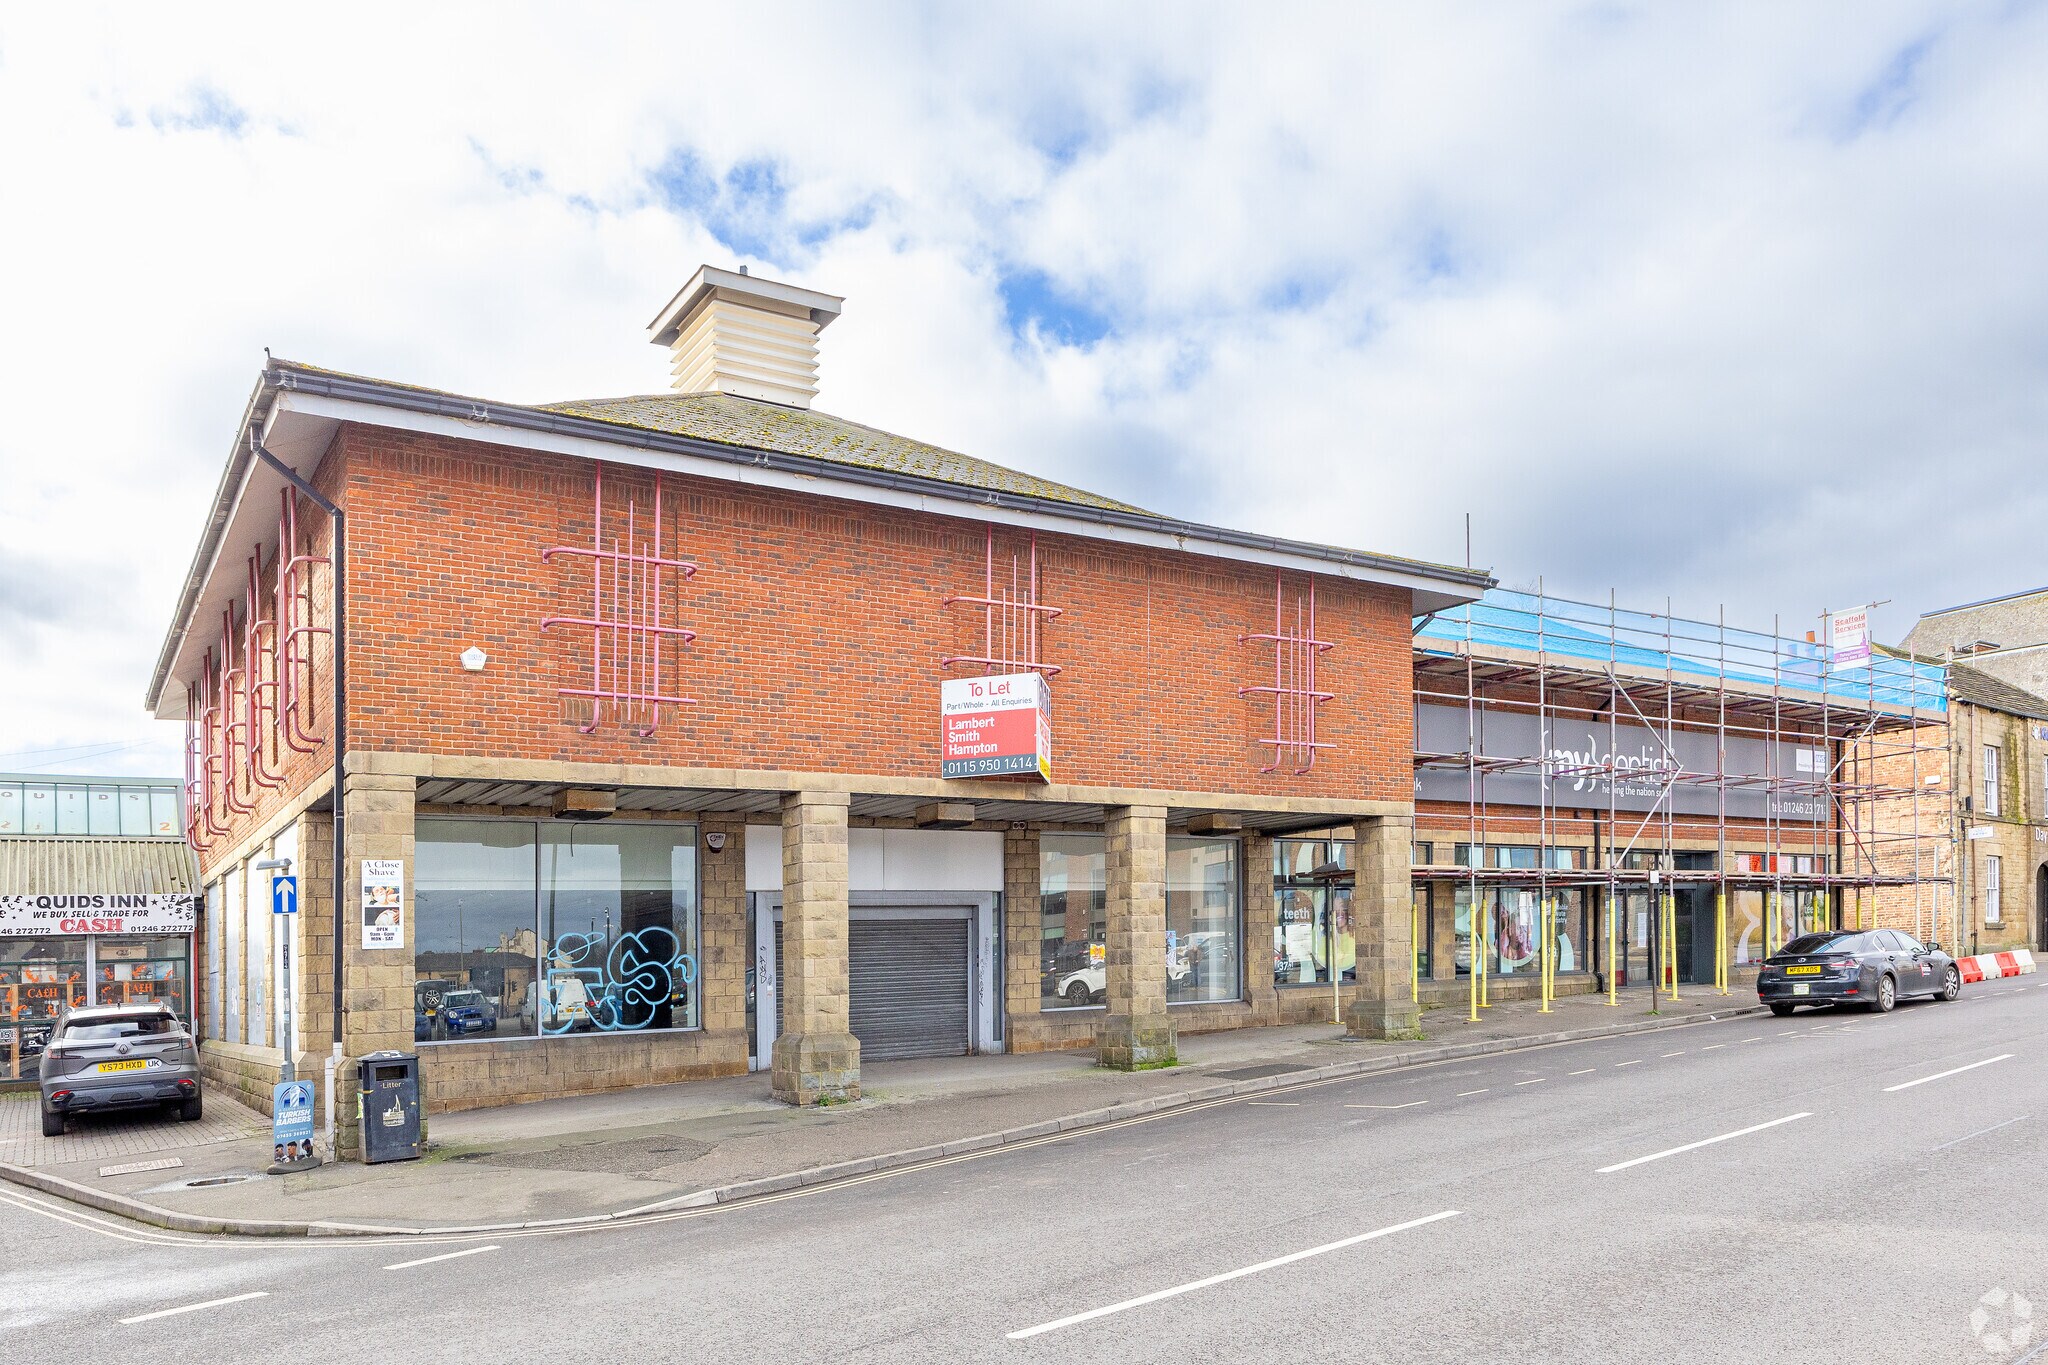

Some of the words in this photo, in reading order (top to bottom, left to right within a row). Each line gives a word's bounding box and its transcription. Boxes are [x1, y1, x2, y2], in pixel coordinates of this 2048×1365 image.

[1834, 613, 1866, 626] Scaffold
[1834, 622, 1866, 634] Services
[968, 682, 983, 697] To
[988, 680, 1011, 696] Let
[946, 701, 984, 710] Part/Whole
[1001, 697, 1033, 707] Enquiries
[948, 716, 995, 730] Lambert
[948, 730, 980, 743] Smith
[948, 742, 998, 756] Hampton
[948, 760, 976, 774] 0115
[979, 758, 1000, 771] 950
[1004, 756, 1032, 769] 1414
[1601, 783, 1625, 797] heing
[1625, 785, 1635, 795] the
[1636, 787, 1655, 797] nation
[1783, 801, 1804, 814] 01246
[2035, 827, 2048, 844] Day
[374, 860, 400, 868] Close
[368, 868, 395, 876] Shave
[36, 895, 105, 909] QUIDS
[110, 895, 147, 908] INN
[33, 911, 47, 919] WE
[50, 911, 68, 919] BUY,
[71, 910, 91, 918] SELL
[1284, 907, 1310, 920] teeth
[60, 918, 124, 934] CASH
[102, 1063, 124, 1071] YS73
[125, 1061, 143, 1069] HXD
[278, 1108, 311, 1119] TURKISH
[276, 1115, 312, 1126] BARBERS
